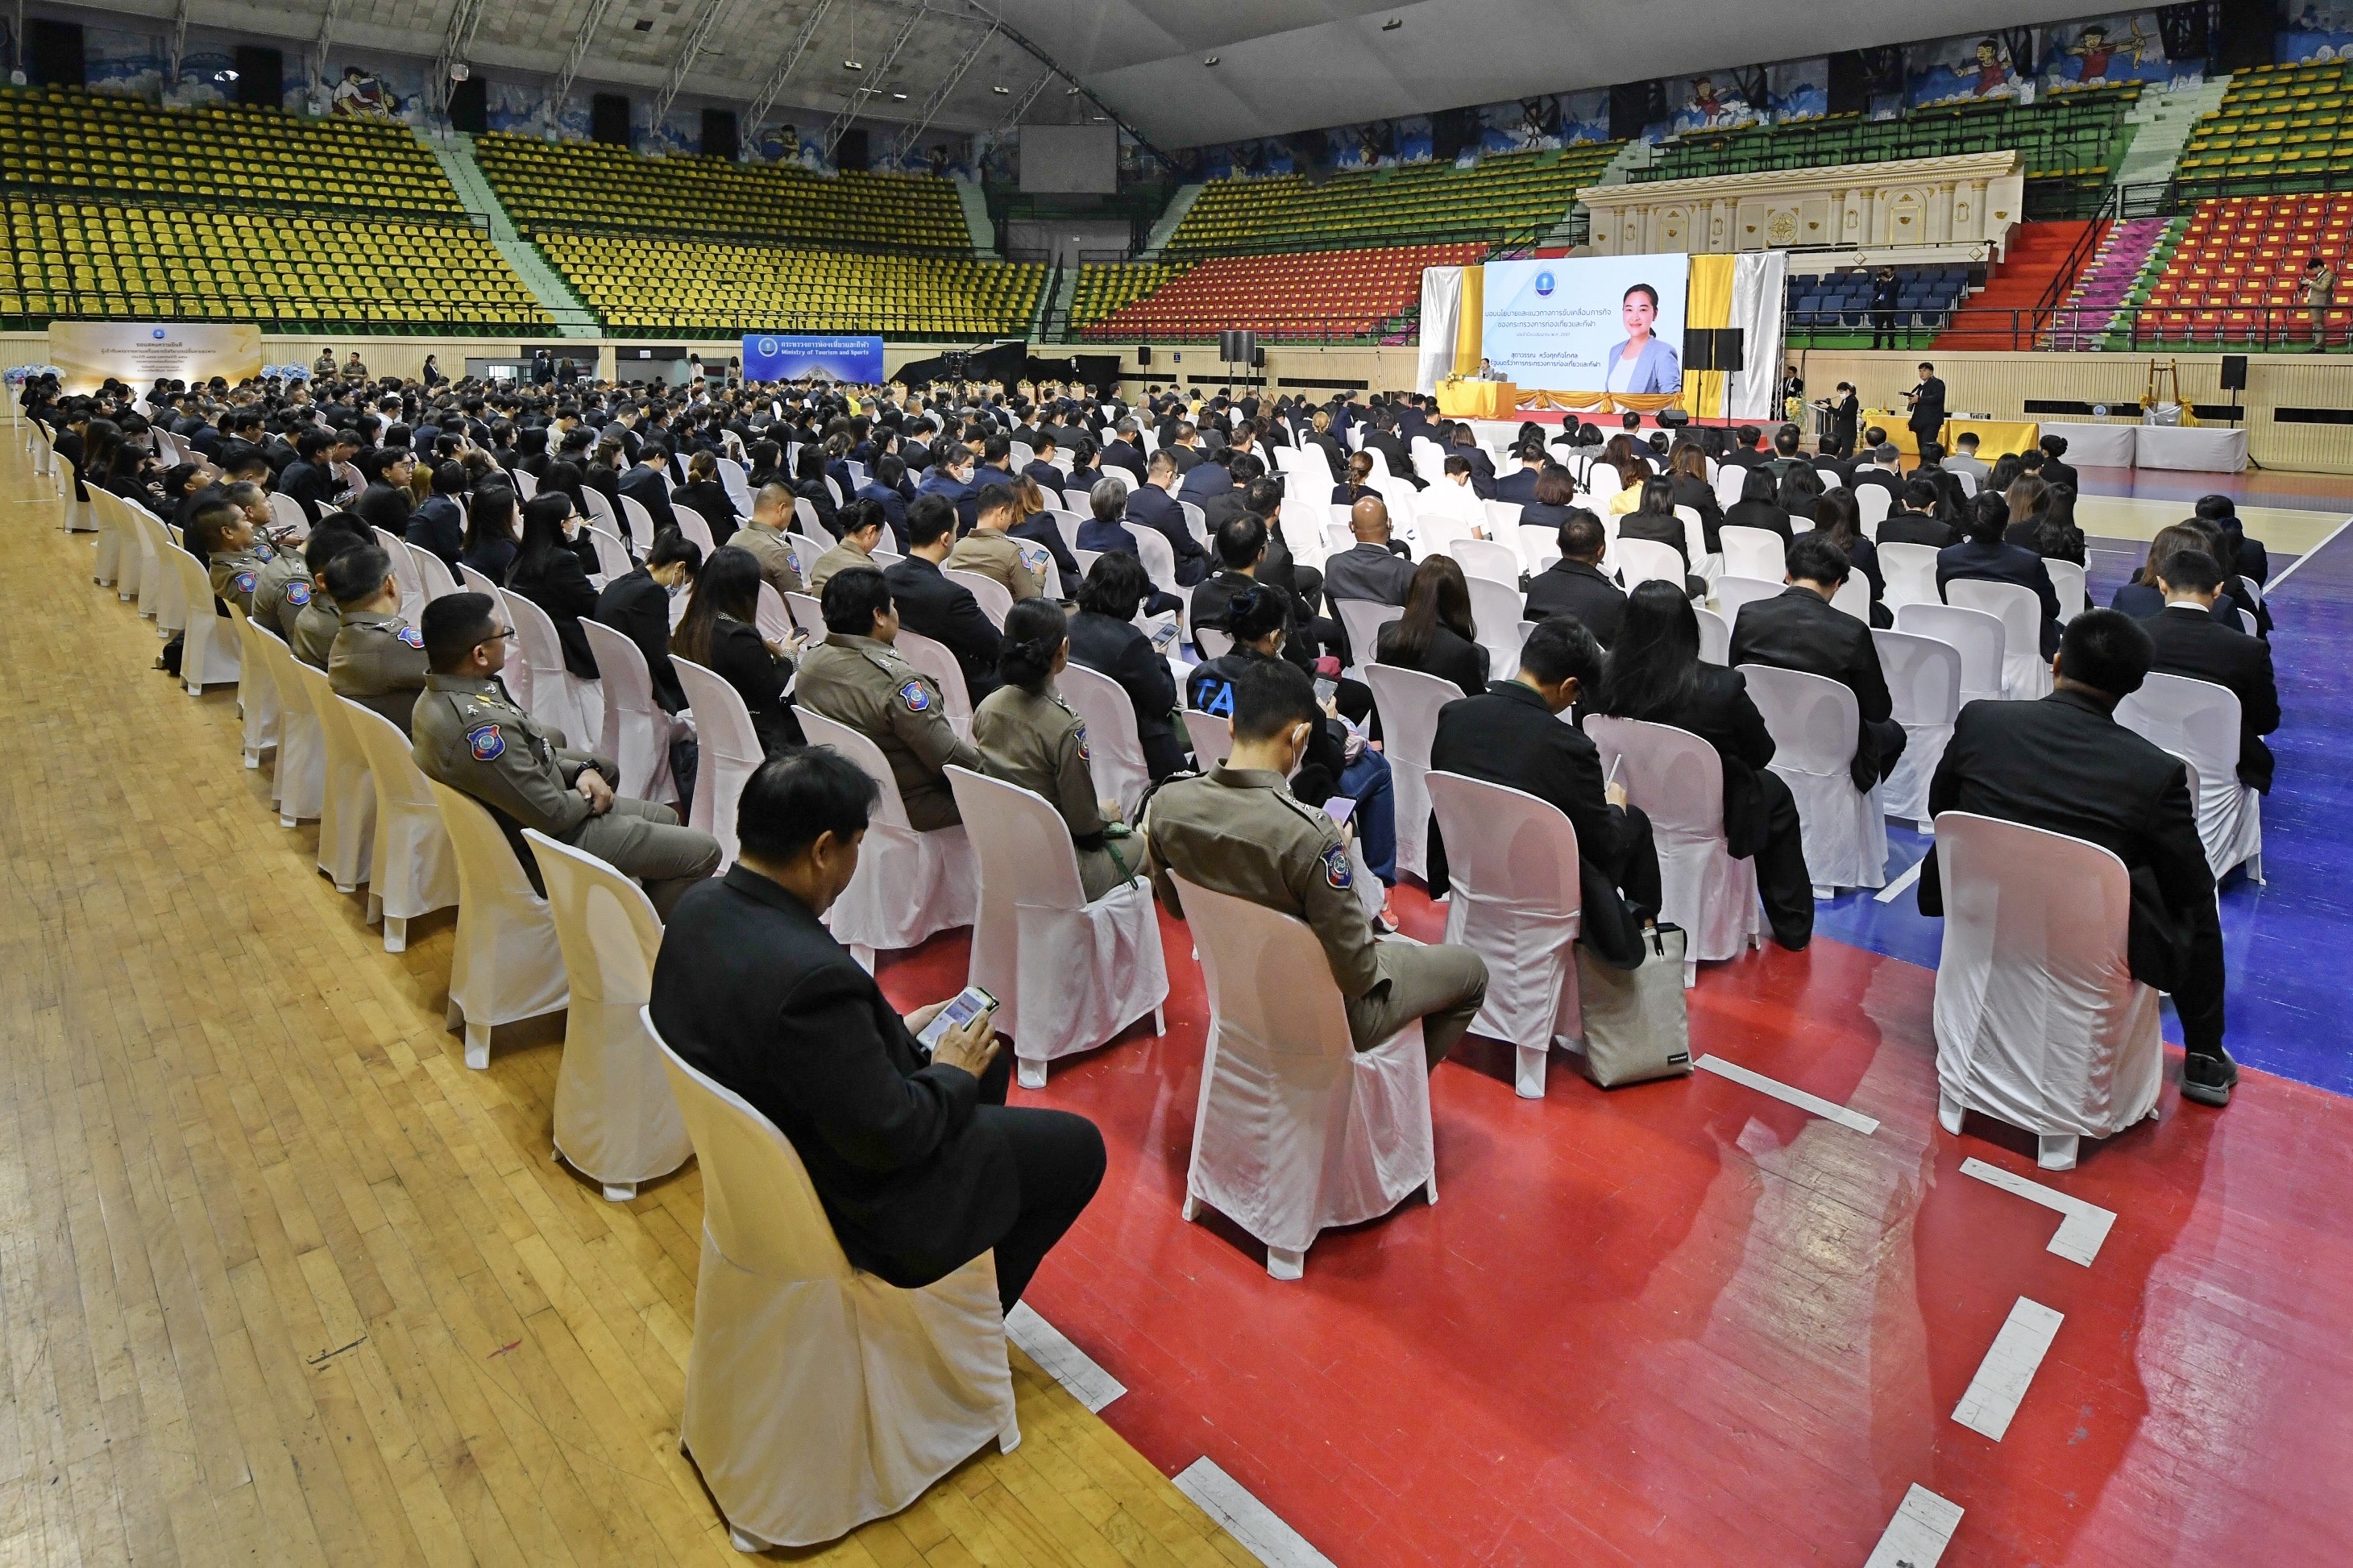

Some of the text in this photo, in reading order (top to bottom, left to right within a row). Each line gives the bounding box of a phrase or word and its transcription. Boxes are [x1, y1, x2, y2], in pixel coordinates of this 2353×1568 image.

[1497, 318, 1596, 328] ของกระทรวงการท่องเที่ยวและกีฬา
[781, 338, 869, 348] กระทรวงการท่องเที่ยวและกีฬา
